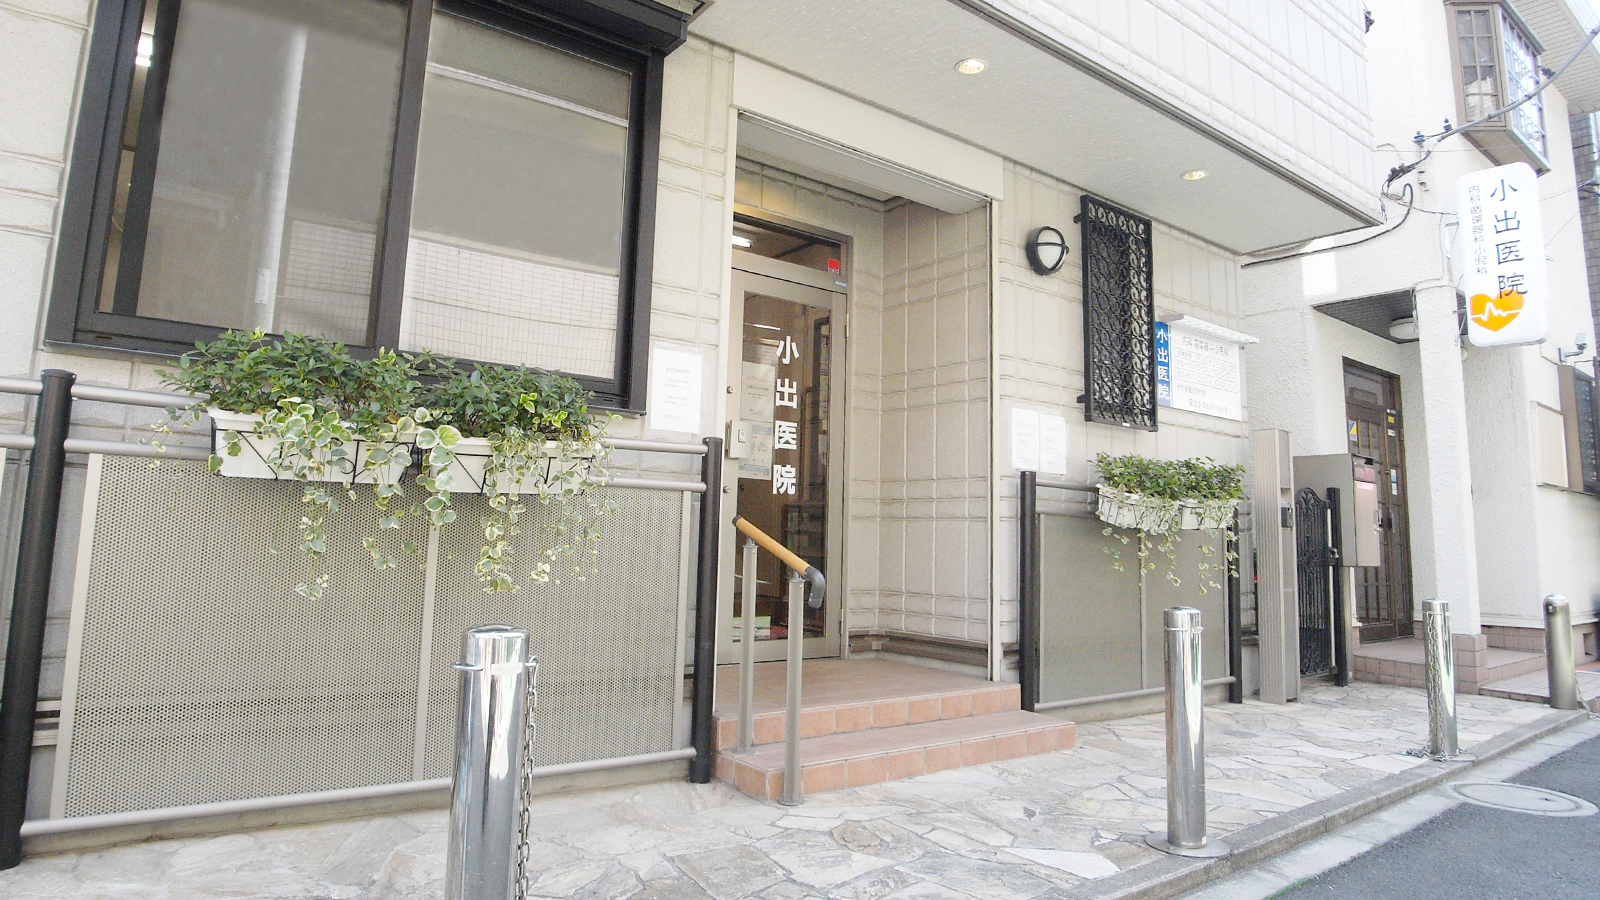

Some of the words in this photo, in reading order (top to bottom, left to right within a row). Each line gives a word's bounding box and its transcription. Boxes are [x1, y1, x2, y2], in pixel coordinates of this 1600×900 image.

[1490, 178, 1528, 299] 小出医院
[772, 335, 800, 495] 小出医院
[1156, 328, 1170, 400] 小出医院
